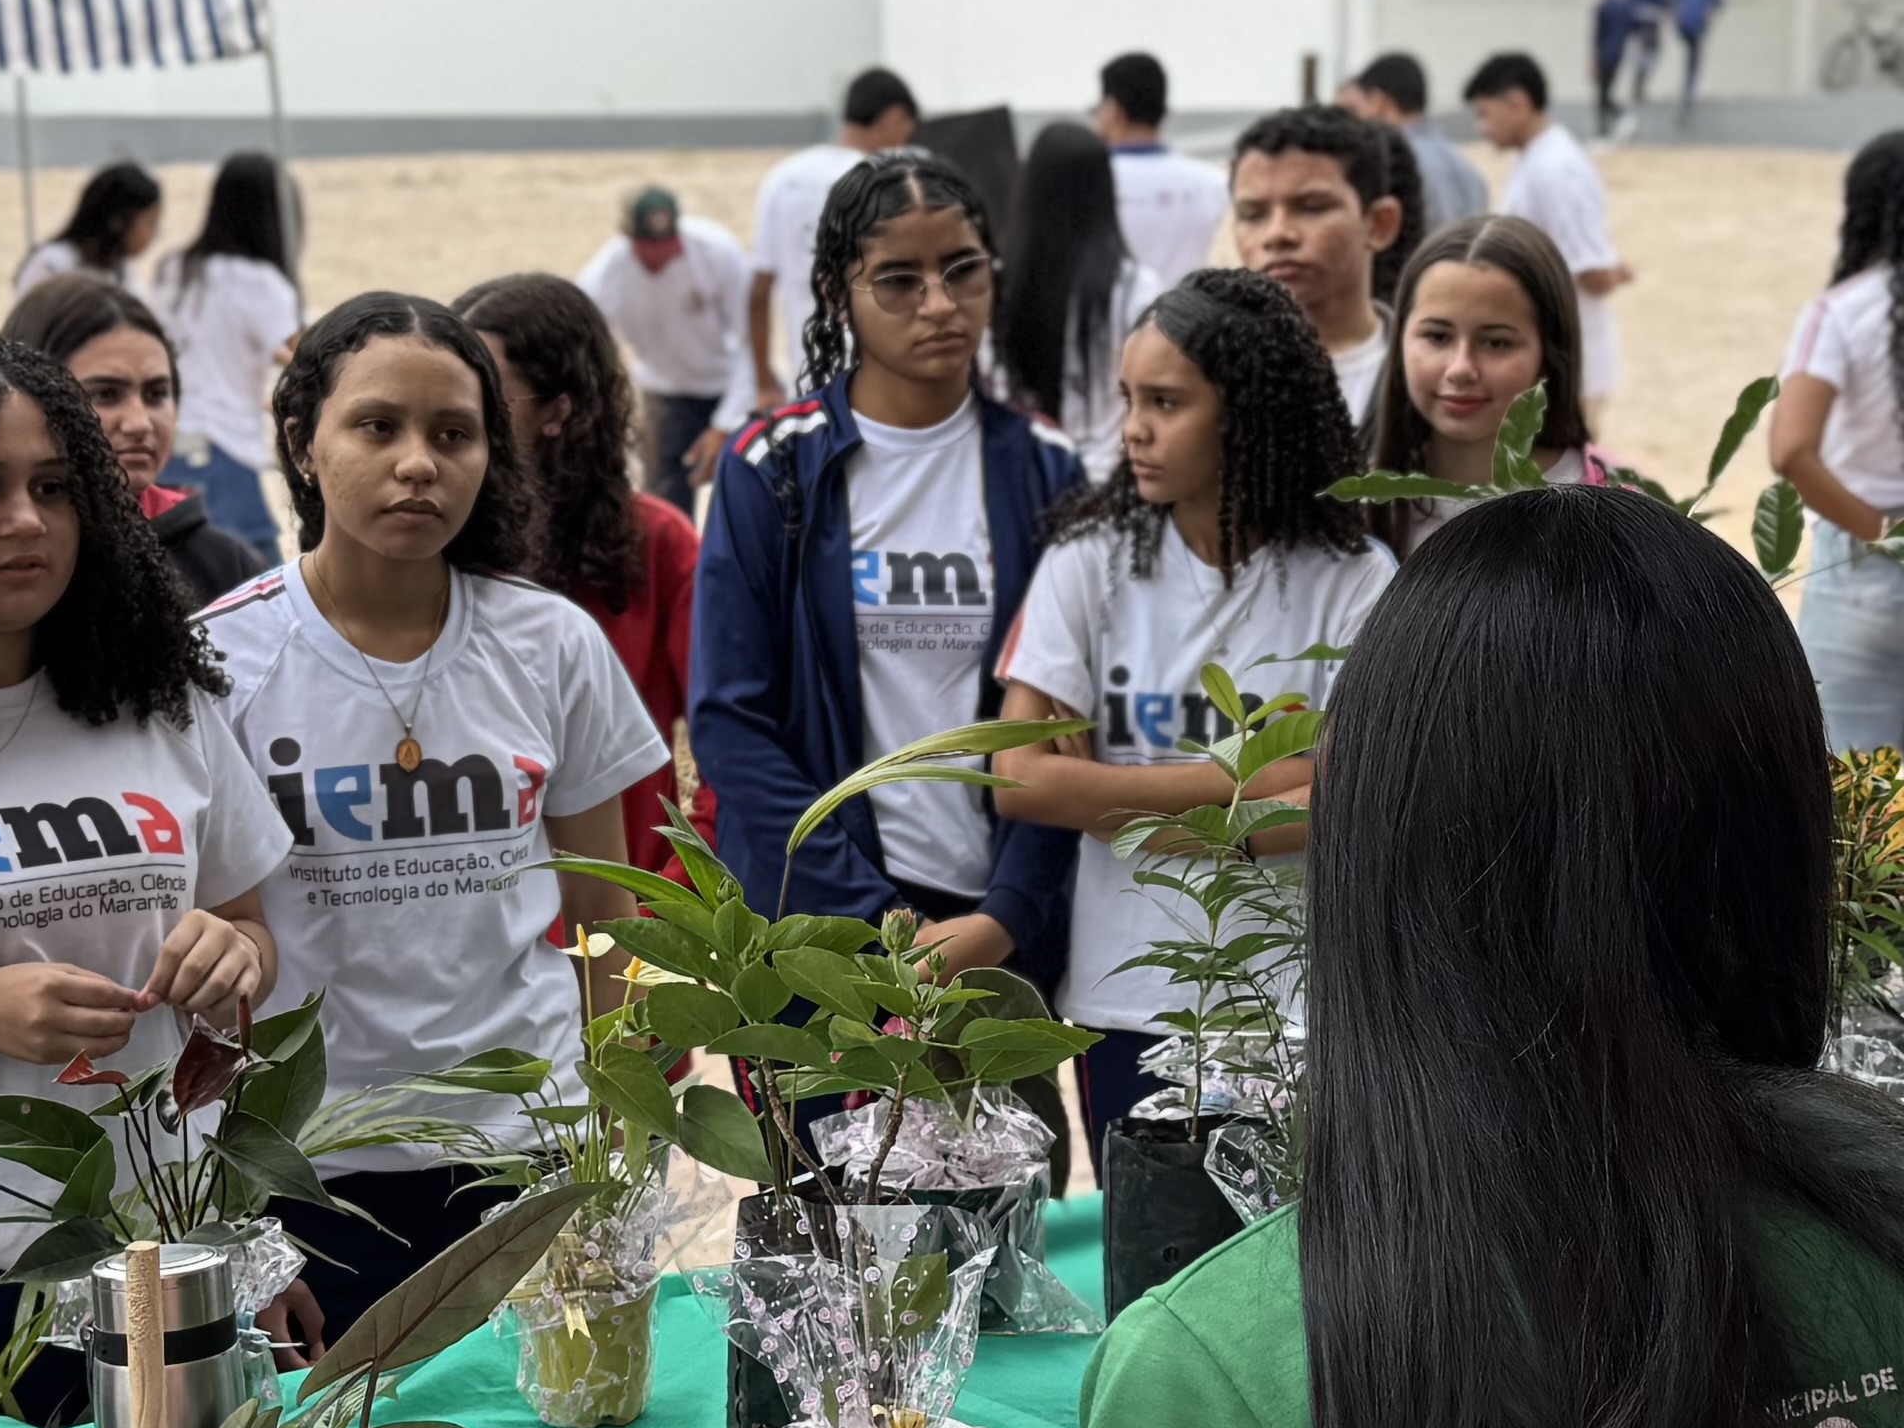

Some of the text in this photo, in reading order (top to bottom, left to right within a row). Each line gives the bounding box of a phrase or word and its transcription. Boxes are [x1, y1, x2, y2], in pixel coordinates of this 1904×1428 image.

[870, 622, 889, 635] de
[917, 637, 937, 650] do
[268, 737, 547, 846] iema
[289, 863, 362, 884] Instituto
[367, 858, 389, 878] de
[395, 852, 494, 876] Educação,
[10, 890, 33, 908] de
[40, 878, 135, 906] Educação,
[69, 902, 93, 919] do
[99, 893, 179, 916] Maranhão
[307, 890, 316, 904] e
[322, 884, 419, 907] Tecnologia
[425, 881, 448, 897] do
[1861, 1366, 1898, 1398] DE
